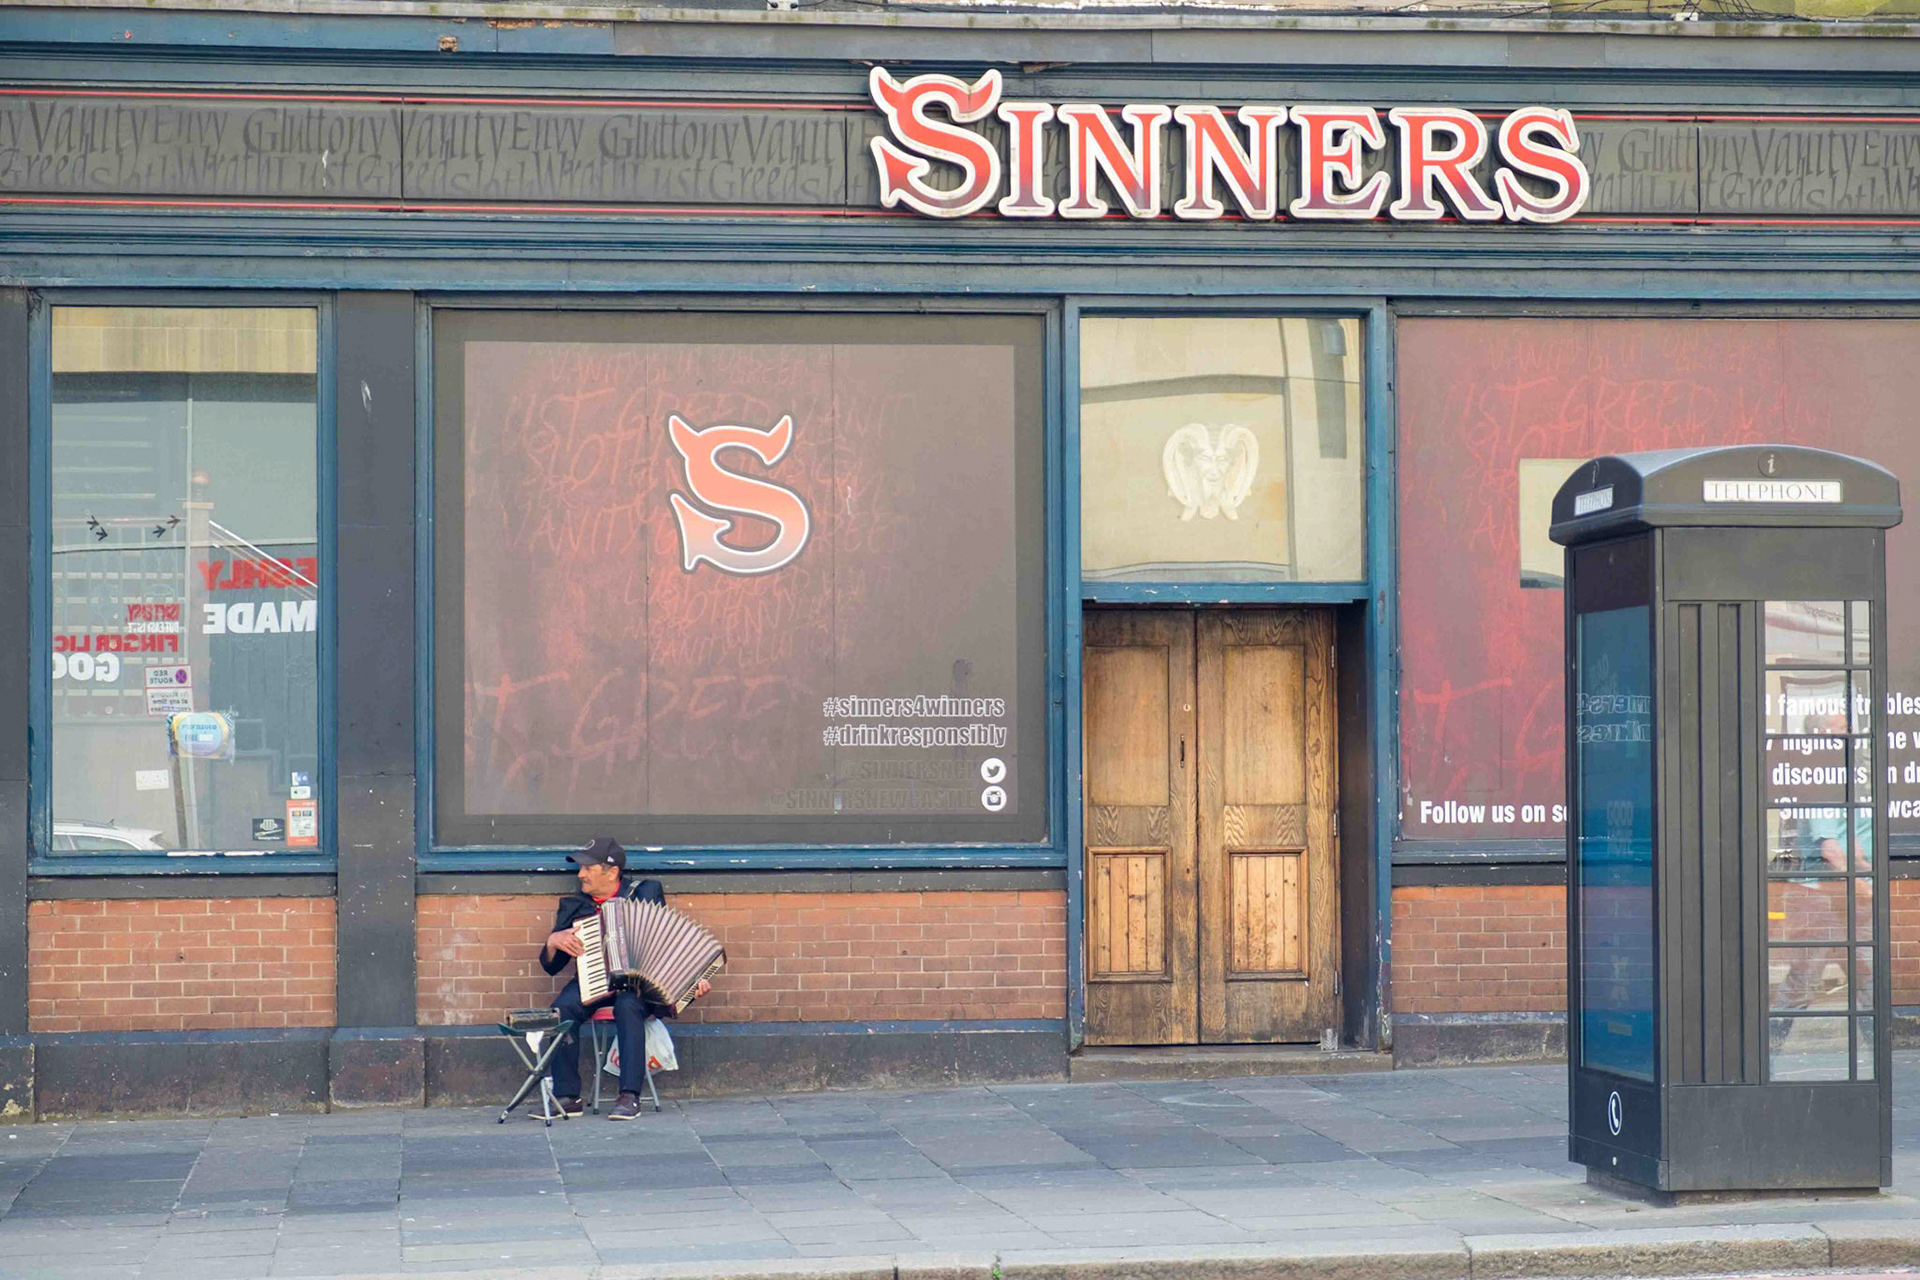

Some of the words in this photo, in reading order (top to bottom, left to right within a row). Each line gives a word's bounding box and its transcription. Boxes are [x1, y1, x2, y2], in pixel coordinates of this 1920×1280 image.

[29, 101, 147, 165] Vanity
[150, 104, 229, 158] Envy
[243, 107, 387, 157] Gluttony
[390, 108, 506, 168] Vanity
[507, 111, 585, 162] Envy
[599, 112, 739, 162] Gluttony
[743, 114, 855, 170] Vanity
[869, 66, 1590, 223] SINNERS
[1618, 126, 1747, 174] Gluttony
[1751, 127, 1859, 182] Vanity
[707, 148, 799, 201] Greed
[1720, 157, 1806, 210] Greed
[668, 414, 810, 574] S
[1710, 483, 1829, 500] TELEPHONE
[822, 695, 1006, 717] #sinners4winners
[822, 724, 1007, 749] #drinkresponsibly
[1420, 801, 1486, 824] Follow
[1492, 804, 1516, 823] us
[1521, 804, 1546, 823] on
